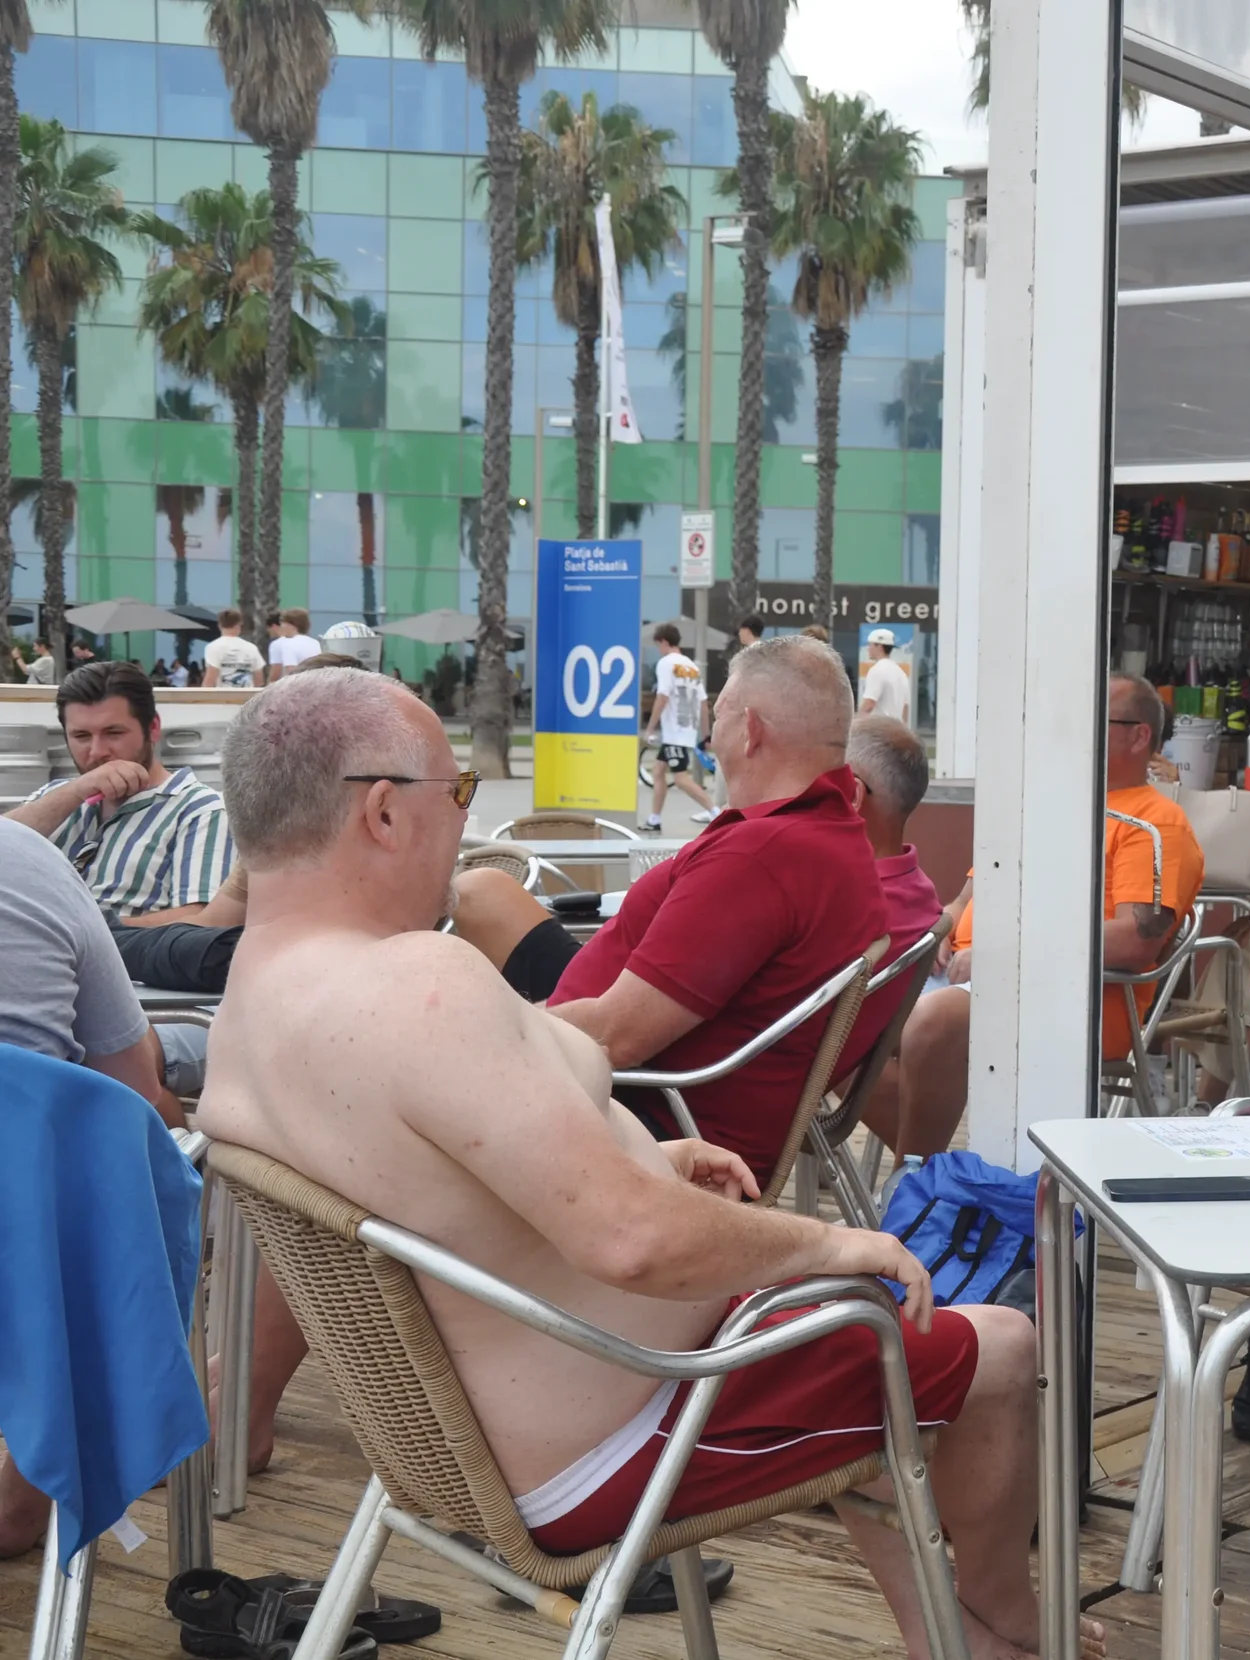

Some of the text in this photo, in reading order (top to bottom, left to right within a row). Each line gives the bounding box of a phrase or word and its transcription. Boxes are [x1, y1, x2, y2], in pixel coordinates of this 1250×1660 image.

[593, 547, 605, 558] de
[564, 560, 586, 572] Sant
[562, 644, 635, 719] 02
